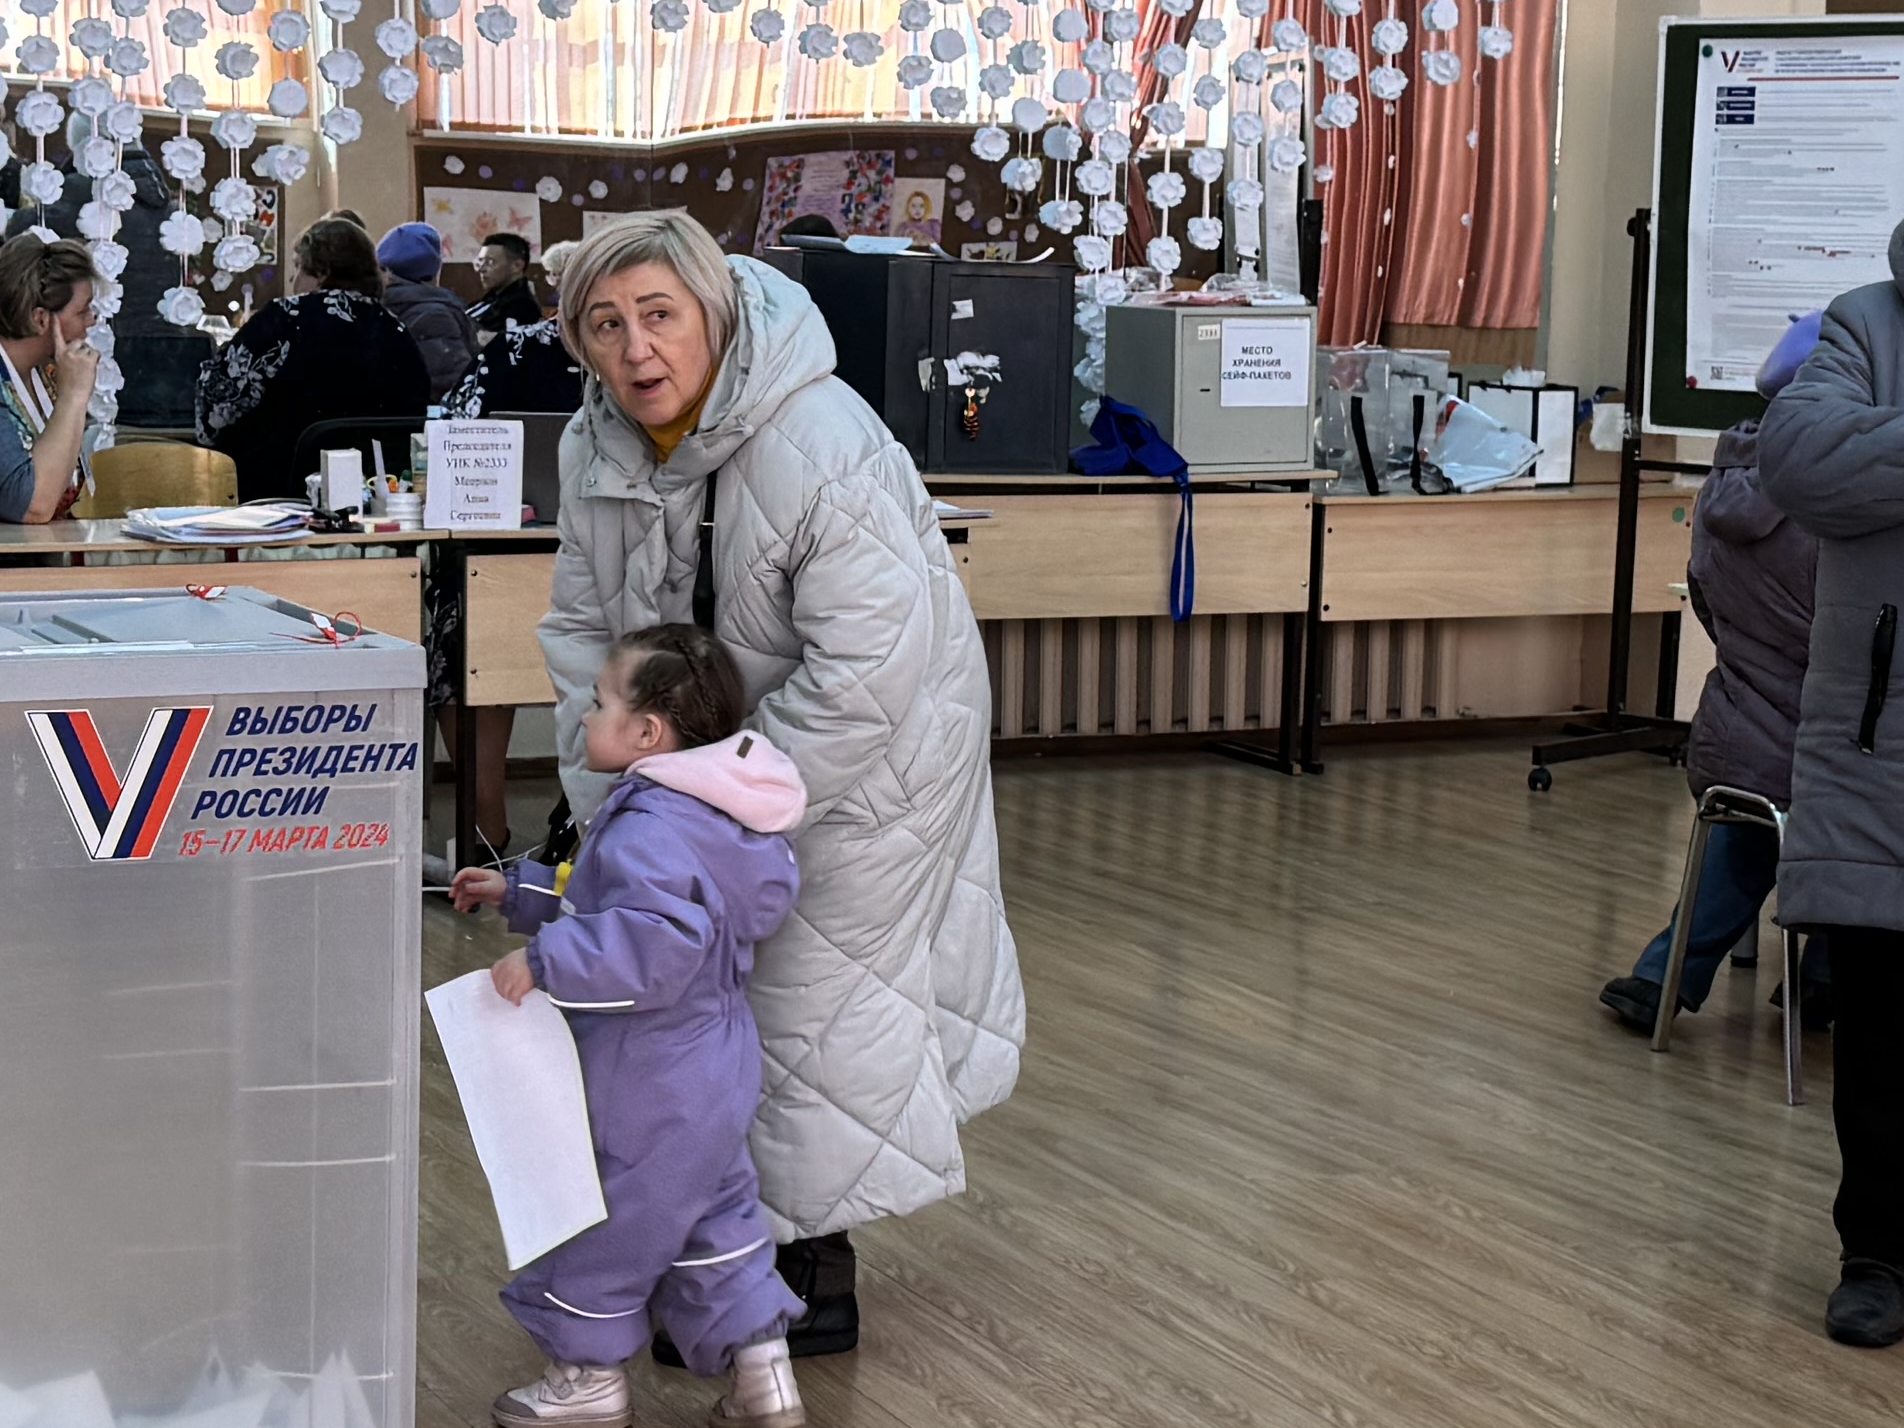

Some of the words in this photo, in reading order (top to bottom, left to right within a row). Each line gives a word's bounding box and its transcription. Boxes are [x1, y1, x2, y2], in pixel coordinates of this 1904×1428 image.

[1231, 358, 1282, 368] ХРАНЕНИЯ
[1241, 346, 1274, 355] МЕСТО
[225, 703, 377, 737] ВЫБОРЫ
[208, 742, 419, 779] ПРЕЗИДЕНТА
[190, 786, 331, 820] РОССИИ
[247, 824, 329, 854] МАРТА
[332, 822, 390, 851] 2024
